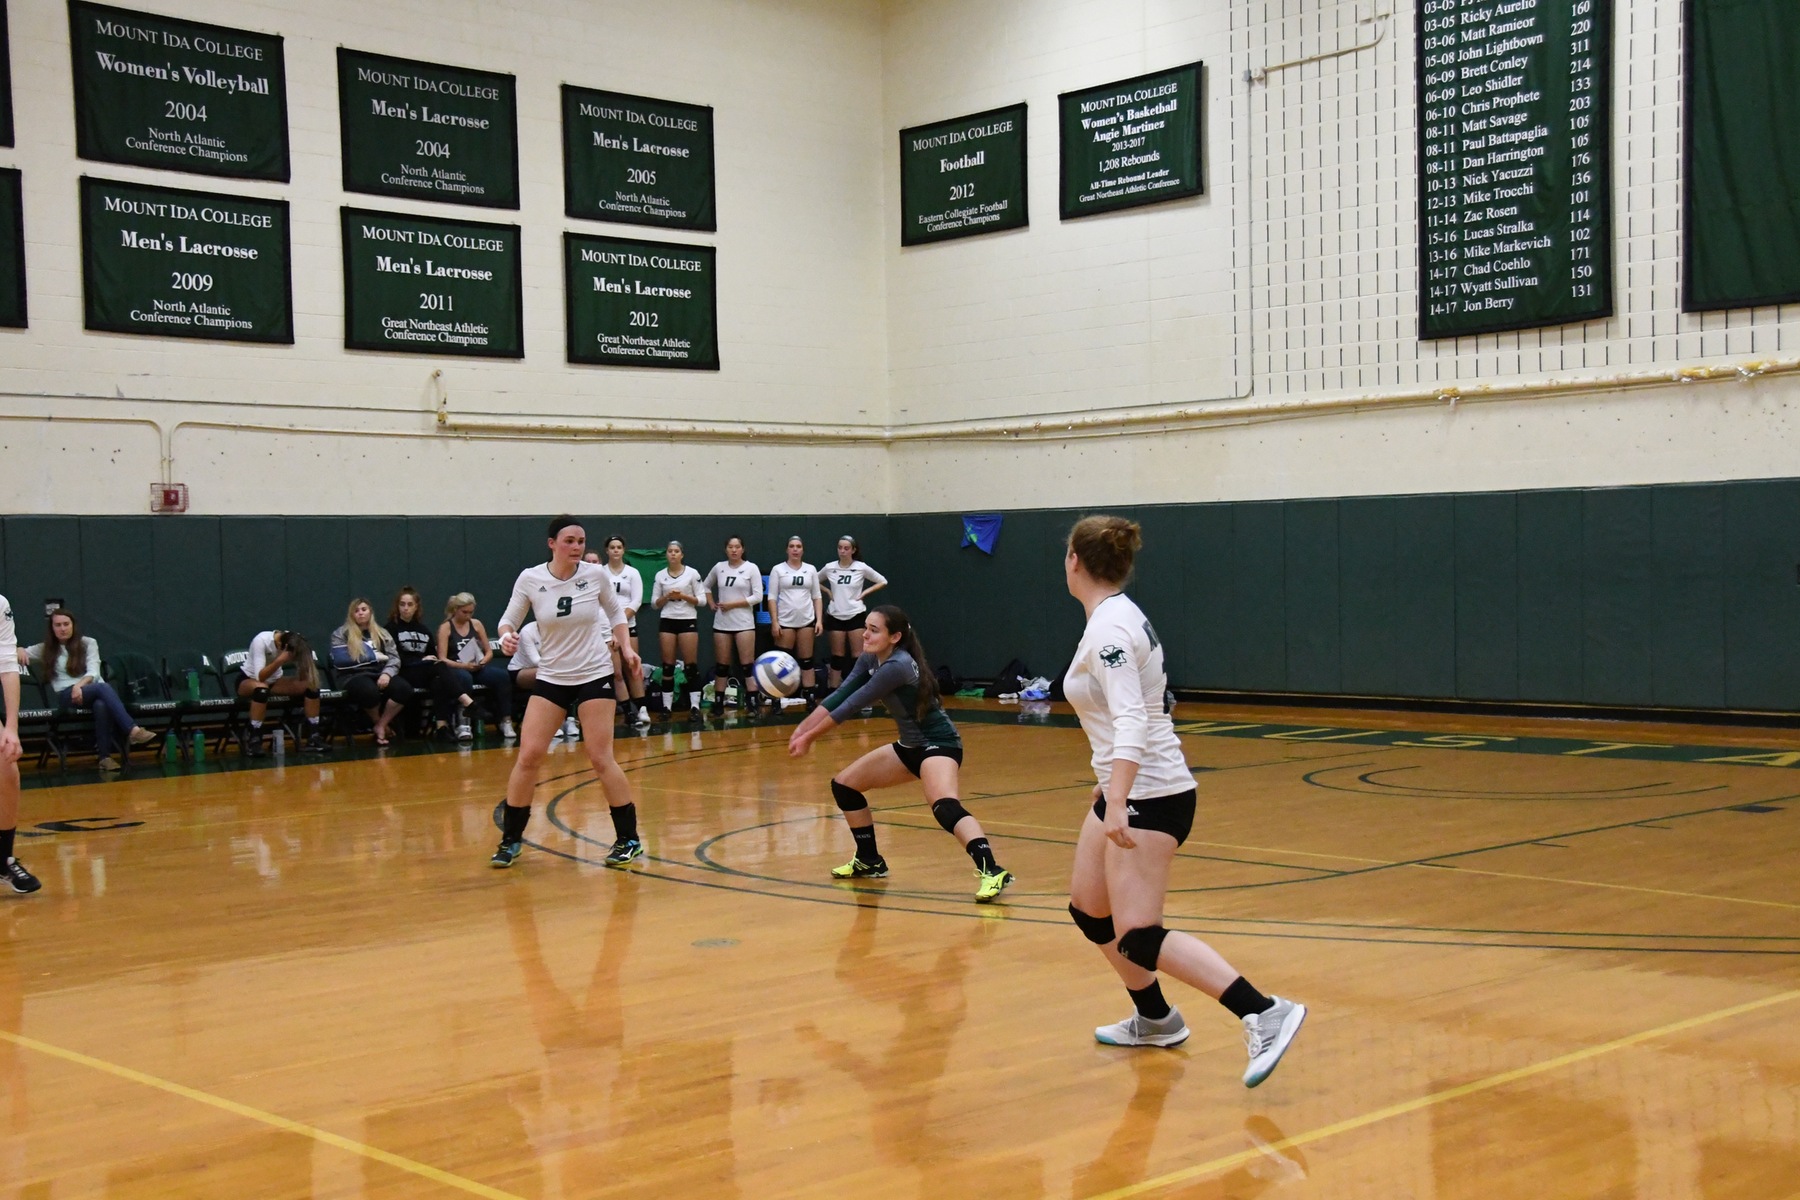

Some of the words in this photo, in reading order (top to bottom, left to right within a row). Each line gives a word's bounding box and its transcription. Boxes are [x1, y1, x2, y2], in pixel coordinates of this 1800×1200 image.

[1424, 15, 1455, 32] 03-05
[1460, 8, 1493, 25] Ricky
[1424, 33, 1456, 50] 03-06
[1461, 28, 1486, 43] Matt
[1572, 0, 1591, 17] 160
[96, 19, 158, 44] MOUNT
[163, 31, 191, 50] IDA
[194, 37, 263, 61] COLLEGE
[1425, 51, 1455, 68] 05-08
[1457, 47, 1483, 62] John
[1485, 34, 1543, 56] Lightbown
[1570, 19, 1591, 36] 220
[96, 51, 180, 82] Women's
[182, 66, 269, 95] Volleyball
[1425, 69, 1456, 86] 06-09
[1461, 64, 1488, 79] Brett
[1490, 55, 1529, 73] Conley
[1570, 38, 1589, 55] 311
[358, 67, 410, 88] MOUNT
[413, 76, 438, 92] IDA
[438, 80, 499, 101] COLLEGE
[1425, 87, 1456, 104] 06-09
[1461, 85, 1483, 97] Leo
[1570, 57, 1592, 74] 214
[1081, 97, 1115, 114] MOUNT
[1116, 94, 1133, 106] IDA
[1134, 82, 1178, 102] COLLEGE
[1127, 99, 1177, 121] Basketball
[1425, 105, 1456, 122] 06-10
[1461, 99, 1491, 115] Chris
[1492, 91, 1540, 109] Prophete
[1571, 76, 1591, 92] 133
[165, 100, 207, 122] 2004
[371, 99, 417, 120] Men's
[422, 106, 489, 129] Lacrosse
[580, 103, 623, 121] MOUNT
[626, 110, 646, 125] IDA
[648, 113, 698, 132] COLLEGE
[1425, 123, 1454, 139] 08-11
[1462, 119, 1487, 133] Matt
[1489, 112, 1528, 128] Savage
[1569, 95, 1591, 112] 203
[148, 127, 181, 142] North
[184, 133, 225, 148] Atlantic
[913, 134, 948, 152] MOUNT
[949, 131, 967, 144] IDA
[967, 120, 1013, 140] COLLEGE
[1093, 128, 1120, 143] Angie
[1122, 120, 1165, 137] Martinez
[1111, 136, 1146, 152] 2013-2017
[1426, 141, 1455, 157] 08-11
[1462, 135, 1485, 151] Paul
[1570, 114, 1589, 130] 105
[125, 136, 186, 155] Conference
[188, 145, 248, 163] Champions
[416, 139, 451, 159] 2004
[593, 131, 629, 151] Men's
[633, 137, 690, 158] Lacrosse
[1426, 159, 1455, 175] 08-11
[1462, 157, 1485, 169] Dan
[1487, 146, 1544, 165] Harrington
[1571, 133, 1589, 149] 105
[940, 150, 984, 173] Football
[1121, 150, 1160, 167] Rebounds
[381, 172, 433, 189] Conference
[434, 179, 485, 195] Champions
[400, 163, 428, 177] North
[431, 168, 466, 182] Atlantic
[627, 168, 656, 185] 2005
[1428, 177, 1456, 192] 10-13
[1462, 172, 1488, 187] Nick
[1572, 152, 1591, 167] 176
[949, 182, 975, 201] 2012
[1427, 195, 1456, 210] 12-13
[1463, 190, 1491, 205] Mike
[1572, 171, 1591, 186] 136
[104, 196, 168, 217] MOUNT
[170, 204, 199, 221] IDA
[200, 207, 272, 228] COLLEGE
[918, 214, 944, 224] Eastern
[944, 207, 978, 220] Collegiate
[979, 199, 1008, 213] Football
[1428, 213, 1457, 227] 11-14
[1463, 210, 1483, 223] Zac
[1486, 206, 1518, 219] Rosen
[1570, 190, 1588, 205] 101
[927, 220, 963, 232] Conference
[963, 213, 1001, 226] Champions
[1428, 230, 1457, 245] 15-16
[1463, 228, 1495, 241] Lucas
[1496, 220, 1534, 236] Stralka
[1570, 208, 1590, 223] 114
[121, 229, 174, 252] Men's
[179, 236, 258, 260] Lacrosse
[362, 225, 415, 243] MOUNT
[418, 231, 442, 246] IDA
[443, 234, 504, 252] COLLEGE
[1429, 248, 1458, 263] 13-16
[1463, 245, 1491, 259] Mike
[1570, 227, 1590, 242] 102
[376, 255, 421, 275] Men's
[426, 260, 493, 281] Lacrosse
[581, 248, 626, 265] MOUNT
[628, 253, 649, 267] IDA
[650, 256, 702, 272] COLLEGE
[1429, 266, 1457, 280] 14-17
[1463, 261, 1491, 277] Chad
[1571, 246, 1589, 261] 171
[172, 272, 213, 292] 2009
[593, 276, 631, 294] Men's
[635, 280, 691, 299] Lacrosse
[1430, 283, 1457, 298] 14-17
[1460, 281, 1492, 296] Wyatt
[1494, 275, 1538, 290] Sullivan
[1571, 265, 1593, 279] 150
[153, 299, 186, 312] North
[189, 302, 231, 316] Atlantic
[420, 293, 453, 311] 2011
[1430, 301, 1457, 316] 14-17
[1463, 300, 1482, 312] Jon
[1484, 297, 1514, 310] Berry
[1571, 284, 1591, 298] 131
[130, 309, 191, 325] Conference
[194, 314, 253, 330] Champions
[381, 316, 408, 329] Great
[408, 318, 453, 332] Northeast
[454, 322, 489, 334] Athletic
[629, 311, 659, 328] 2012
[384, 328, 437, 342] Conference
[438, 331, 488, 347] Champions
[600, 343, 645, 356] Conference
[645, 346, 689, 360] Champions
[725, 576, 737, 587] 17
[792, 576, 804, 586] 10
[837, 575, 852, 585] 20
[556, 596, 573, 618] 9
[19, 710, 53, 718] USTANGS
